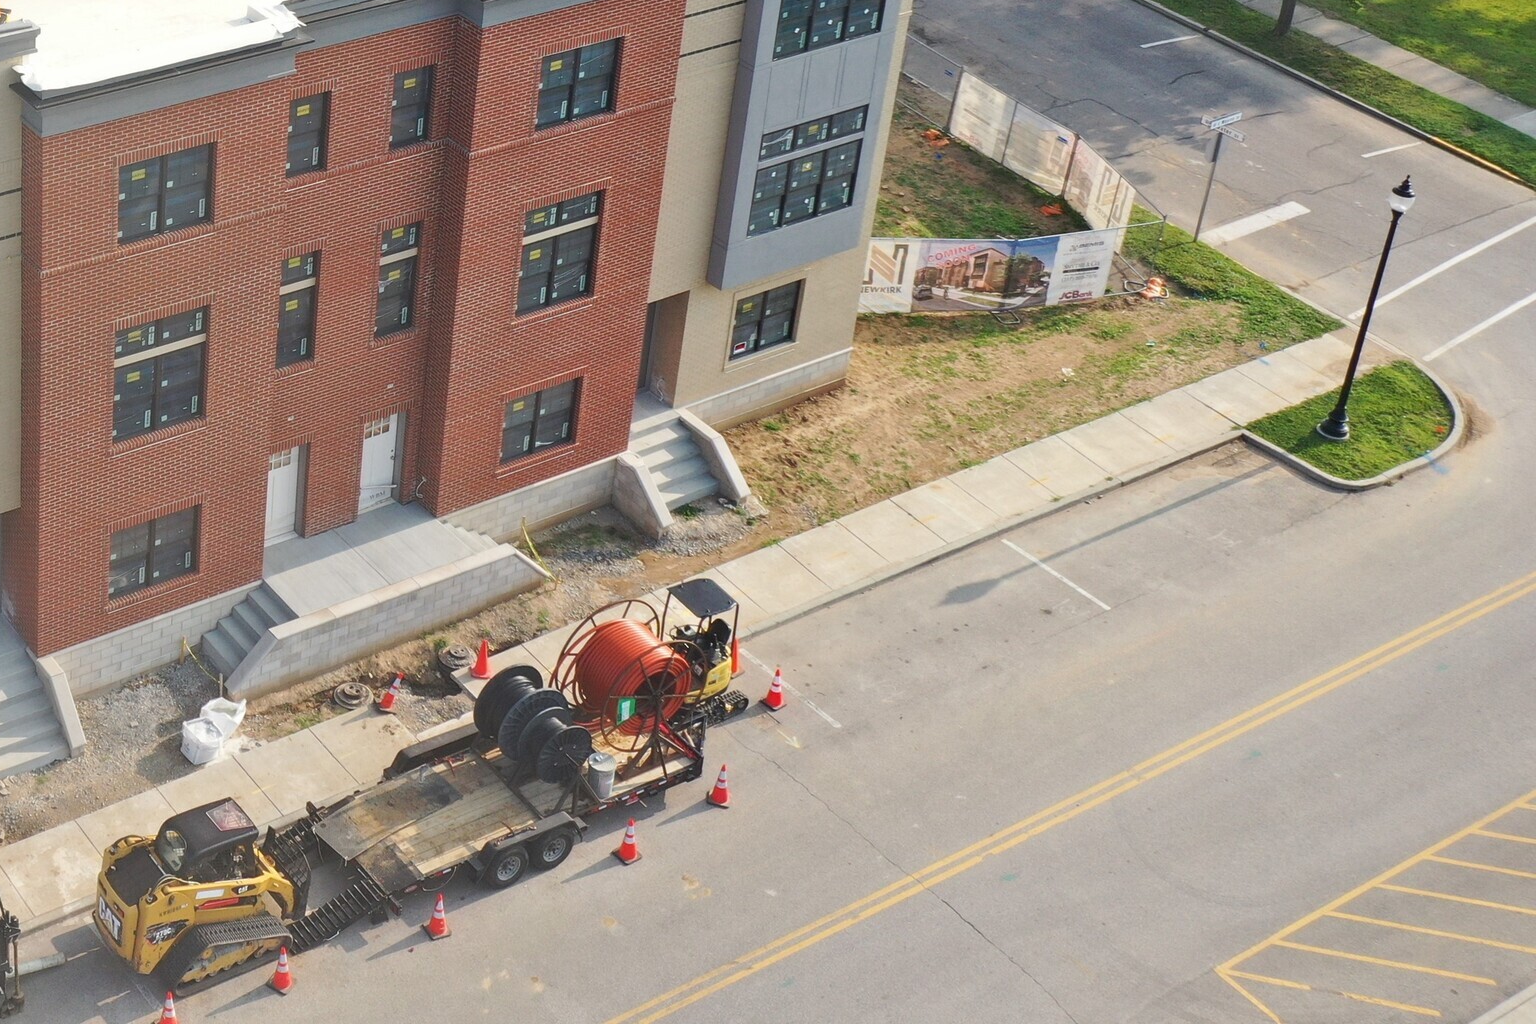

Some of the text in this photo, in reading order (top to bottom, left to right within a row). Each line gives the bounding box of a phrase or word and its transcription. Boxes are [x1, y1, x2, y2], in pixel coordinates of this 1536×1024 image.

[927, 244, 977, 262] COMING
[936, 255, 971, 269] SOON
[1059, 290, 1093, 300] JCBank
[237, 885, 248, 894] CAT
[99, 896, 121, 941] CAT
